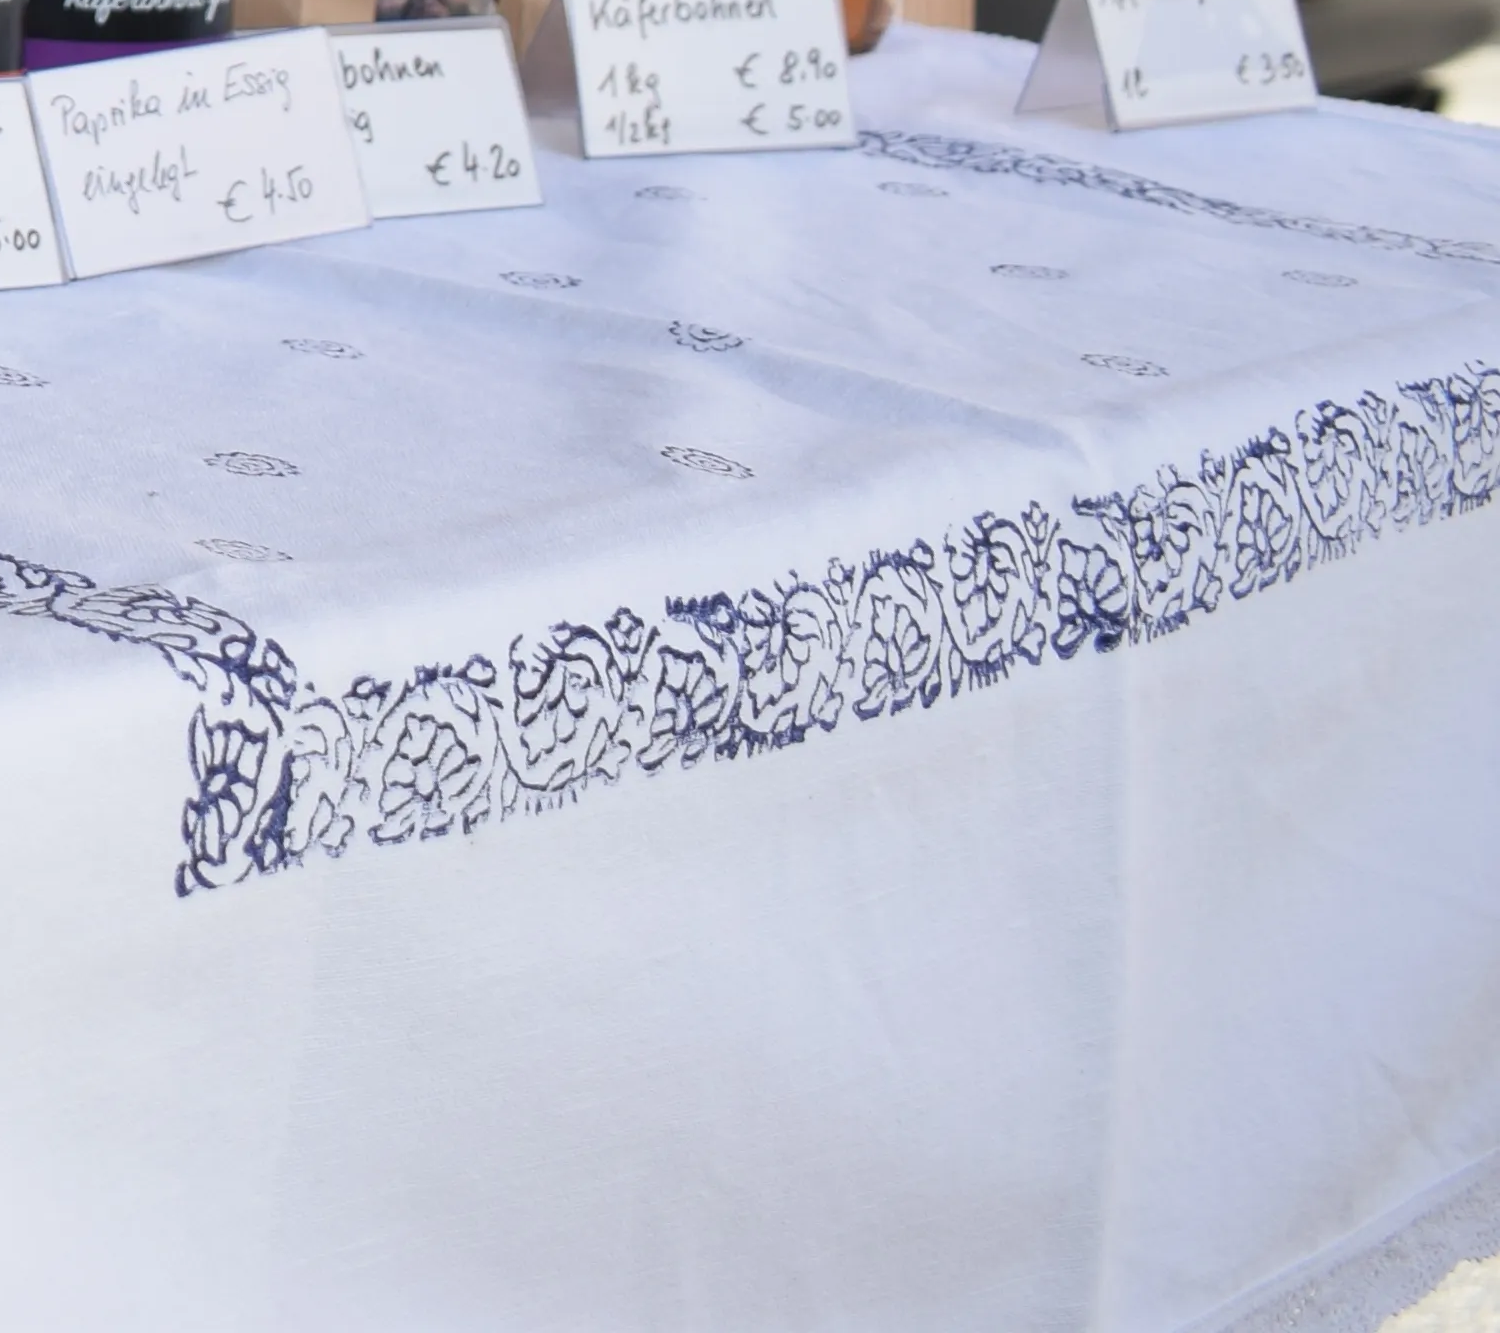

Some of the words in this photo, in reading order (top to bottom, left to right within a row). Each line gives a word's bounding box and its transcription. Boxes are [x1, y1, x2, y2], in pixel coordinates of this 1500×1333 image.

[733, 52, 760, 88] €
[778, 47, 838, 85] 8.90
[50, 79, 162, 147] Paprika
[176, 72, 212, 113] in
[222, 62, 291, 113] Essig
[740, 103, 769, 136] €
[786, 104, 842, 132] 5.00
[82, 144, 200, 215] eingelegt
[425, 150, 451, 187] €
[462, 139, 522, 182] 4.20
[216, 179, 254, 223] €
[261, 165, 313, 216] 4.50
